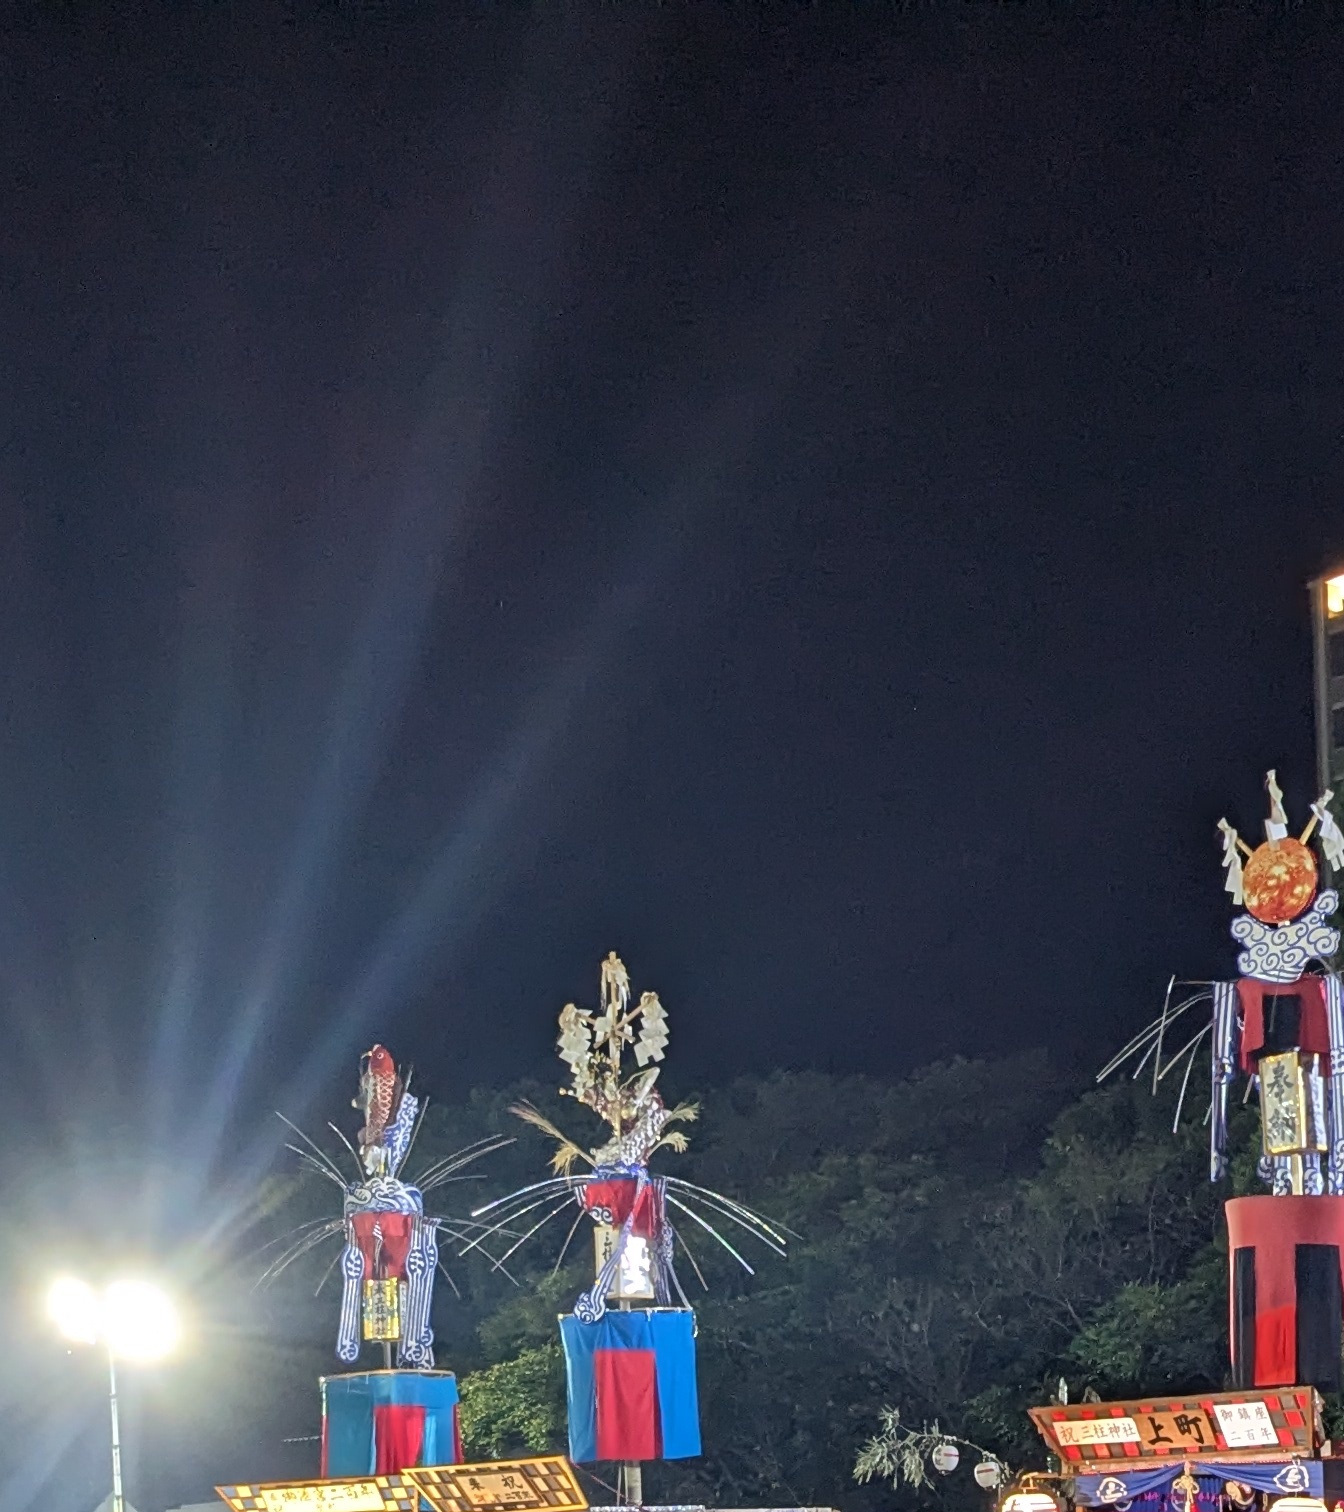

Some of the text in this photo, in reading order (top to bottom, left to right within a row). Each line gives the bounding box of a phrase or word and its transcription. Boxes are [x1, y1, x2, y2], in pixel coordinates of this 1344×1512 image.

[1221, 1406, 1268, 1422] 御鎮座
[1147, 1413, 1205, 1445] 上町
[1231, 1426, 1272, 1441] 二百年
